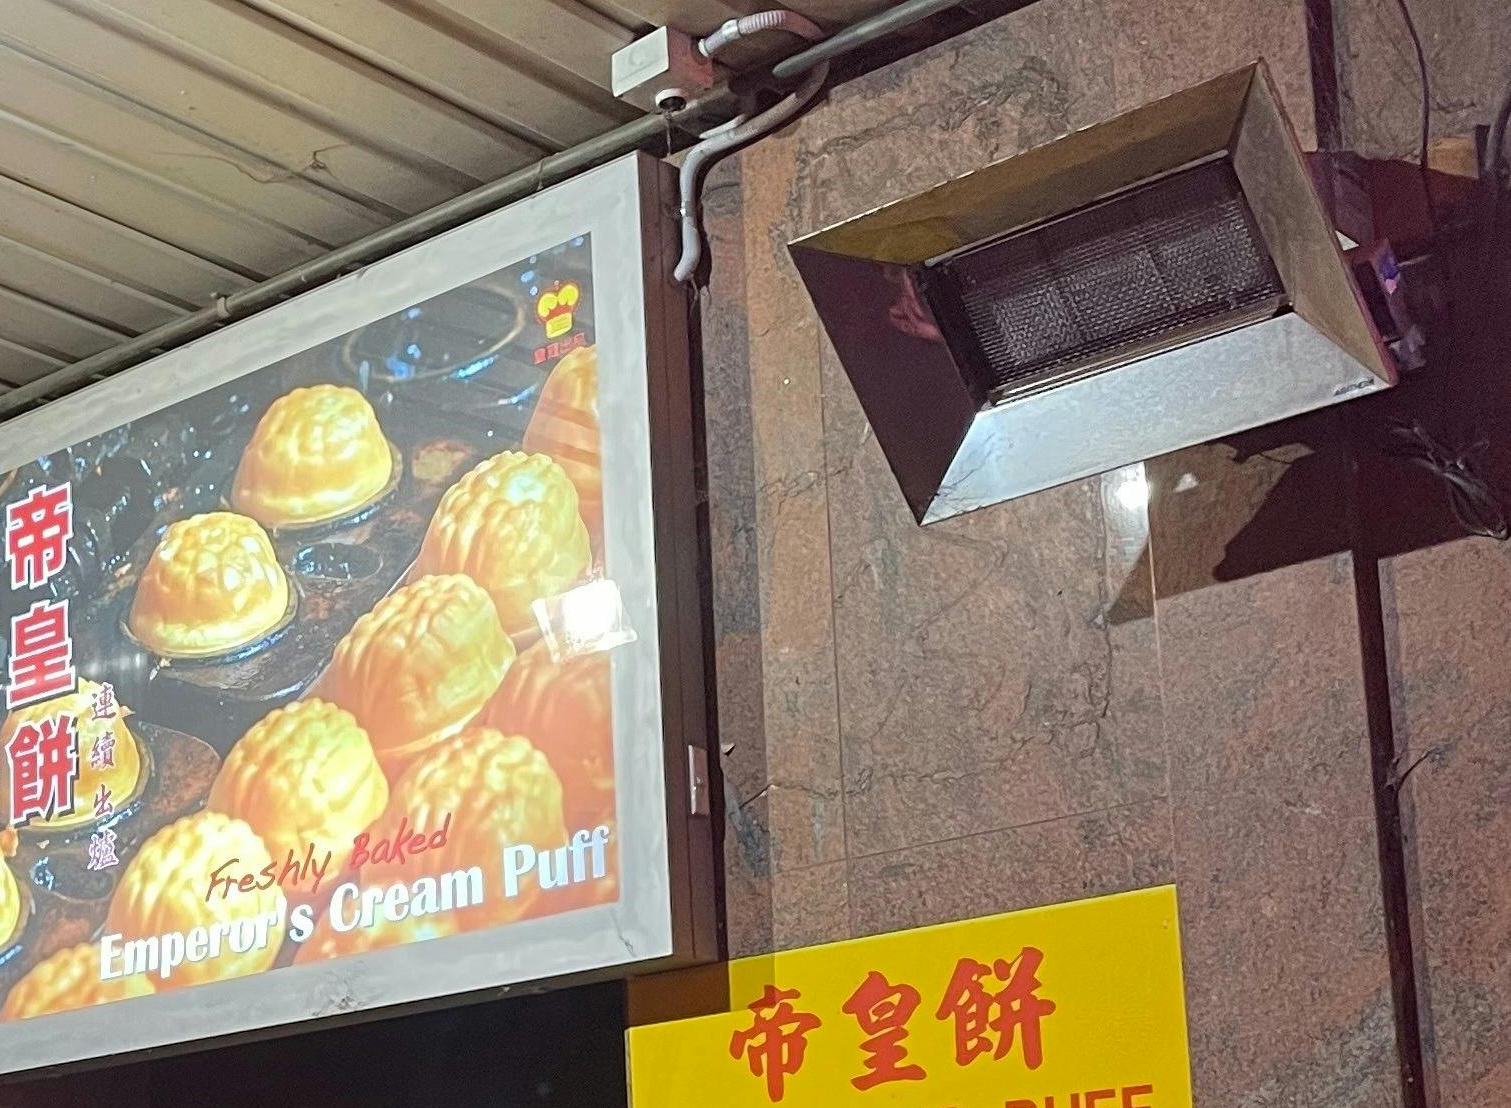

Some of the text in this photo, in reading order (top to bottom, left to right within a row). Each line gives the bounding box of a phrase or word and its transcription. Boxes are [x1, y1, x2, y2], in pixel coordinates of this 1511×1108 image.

[5, 481, 79, 826] 帝皇餅
[86, 681, 122, 873] 連續出爐
[99, 825, 610, 981] Emperor's Cream Puff
[205, 812, 450, 904] Freshly Baked
[729, 946, 1057, 1103] 帝皇餅
